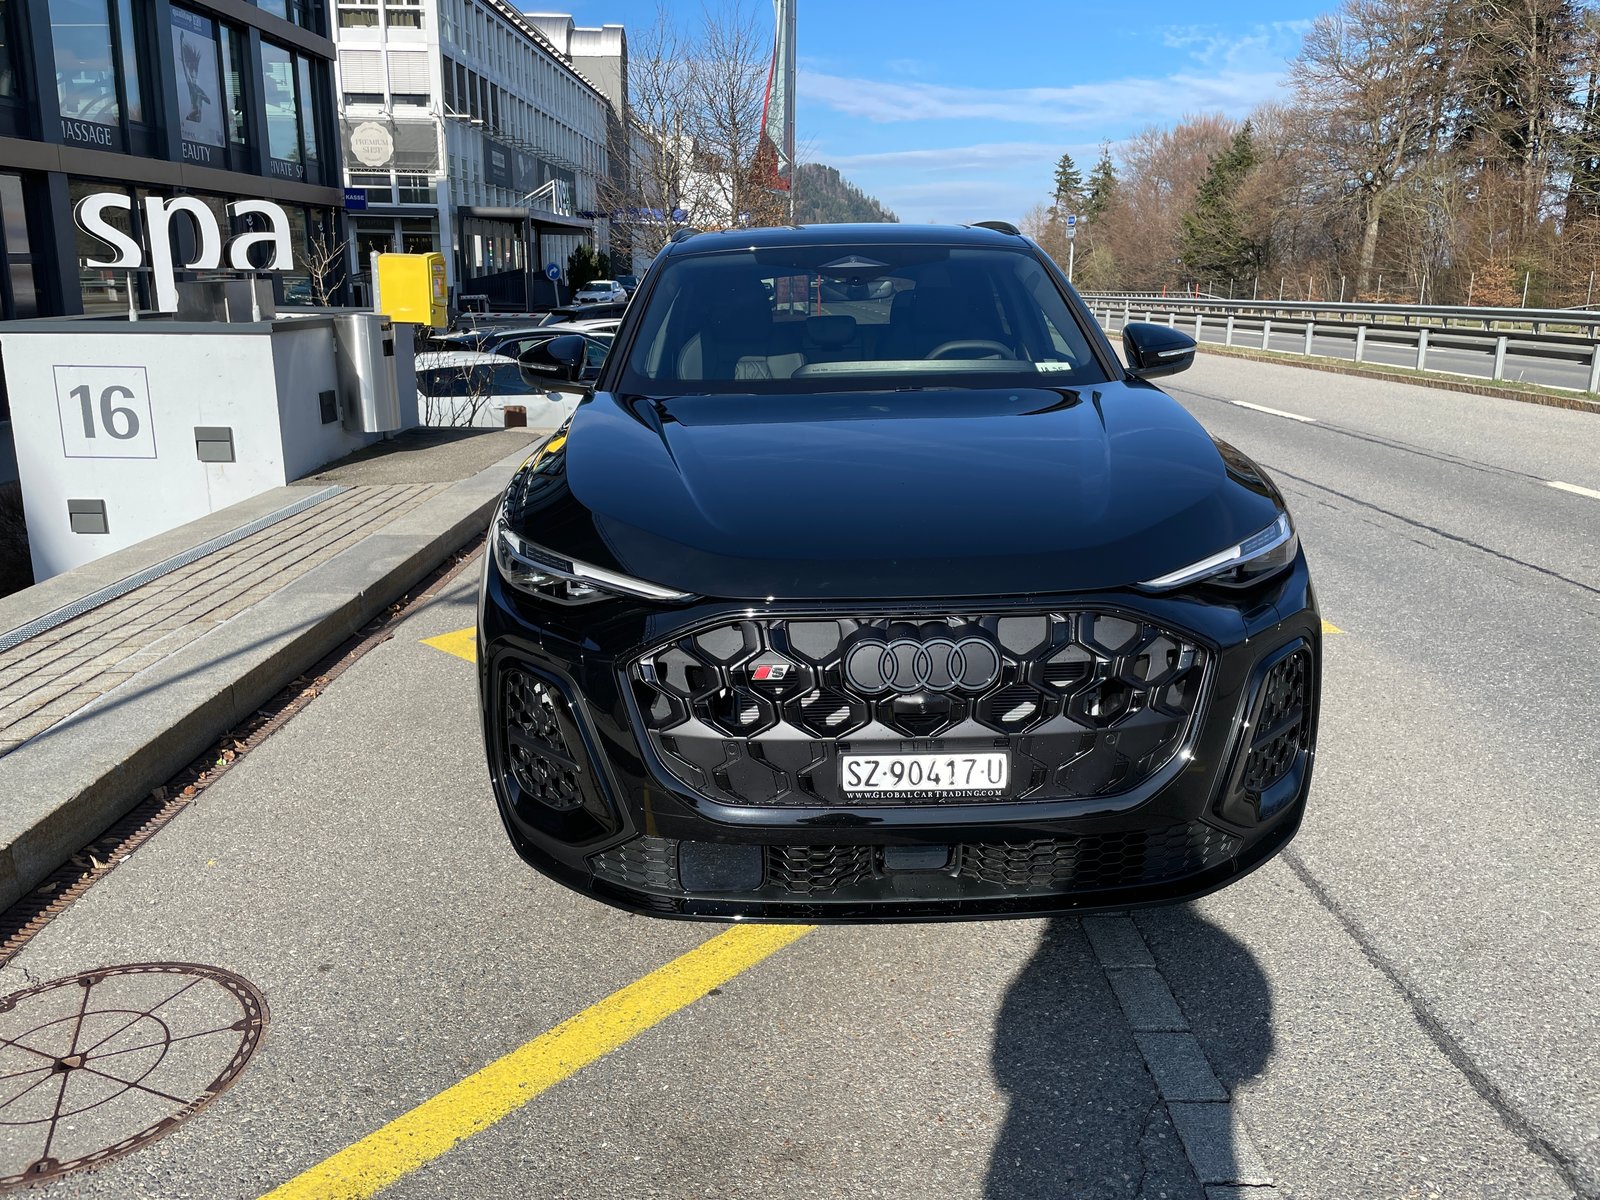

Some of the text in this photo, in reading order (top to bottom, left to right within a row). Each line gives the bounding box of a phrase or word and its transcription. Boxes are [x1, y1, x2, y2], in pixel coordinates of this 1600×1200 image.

[182, 142, 211, 162] EAUTY
[271, 160, 304, 178] IVATE SP
[74, 191, 295, 313] spa
[69, 384, 141, 440] 16
